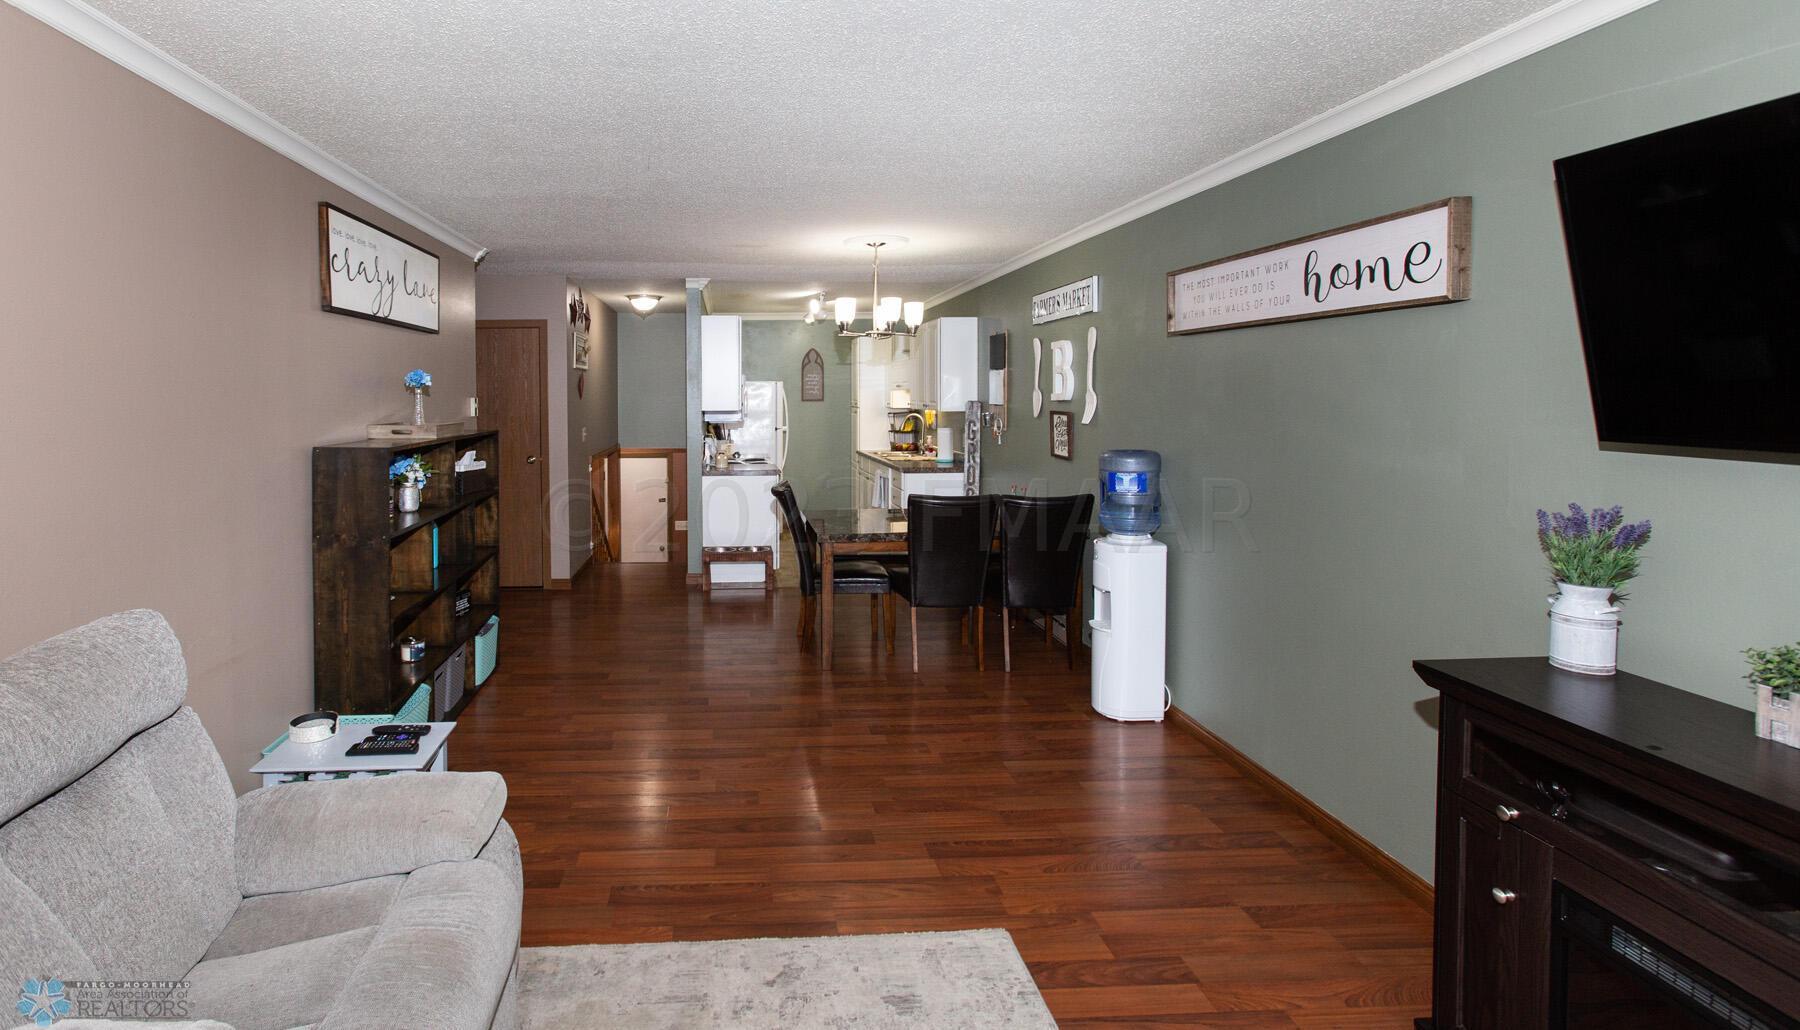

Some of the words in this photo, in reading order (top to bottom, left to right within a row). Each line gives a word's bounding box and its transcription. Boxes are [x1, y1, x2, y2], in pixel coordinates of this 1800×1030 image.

[331, 248, 400, 318] crazy
[1183, 282, 1195, 292] THE
[1197, 277, 1214, 290] MOST
[1217, 266, 1261, 284] IMPORTANT
[1264, 260, 1290, 275] WORK
[1303, 241, 1443, 303] home
[1062, 284, 1091, 312] MARKET
[1182, 309, 1206, 321] WITHIN
[1208, 305, 1222, 317] THE
[1225, 301, 1251, 314] WALLS
[1254, 298, 1264, 310] OF
[1268, 294, 1291, 307] YOUR
[1193, 294, 1206, 305] YOU
[1209, 290, 1226, 302] WILL
[1229, 286, 1249, 298] EVER
[1252, 282, 1263, 294] DO
[1266, 280, 1276, 291] IS
